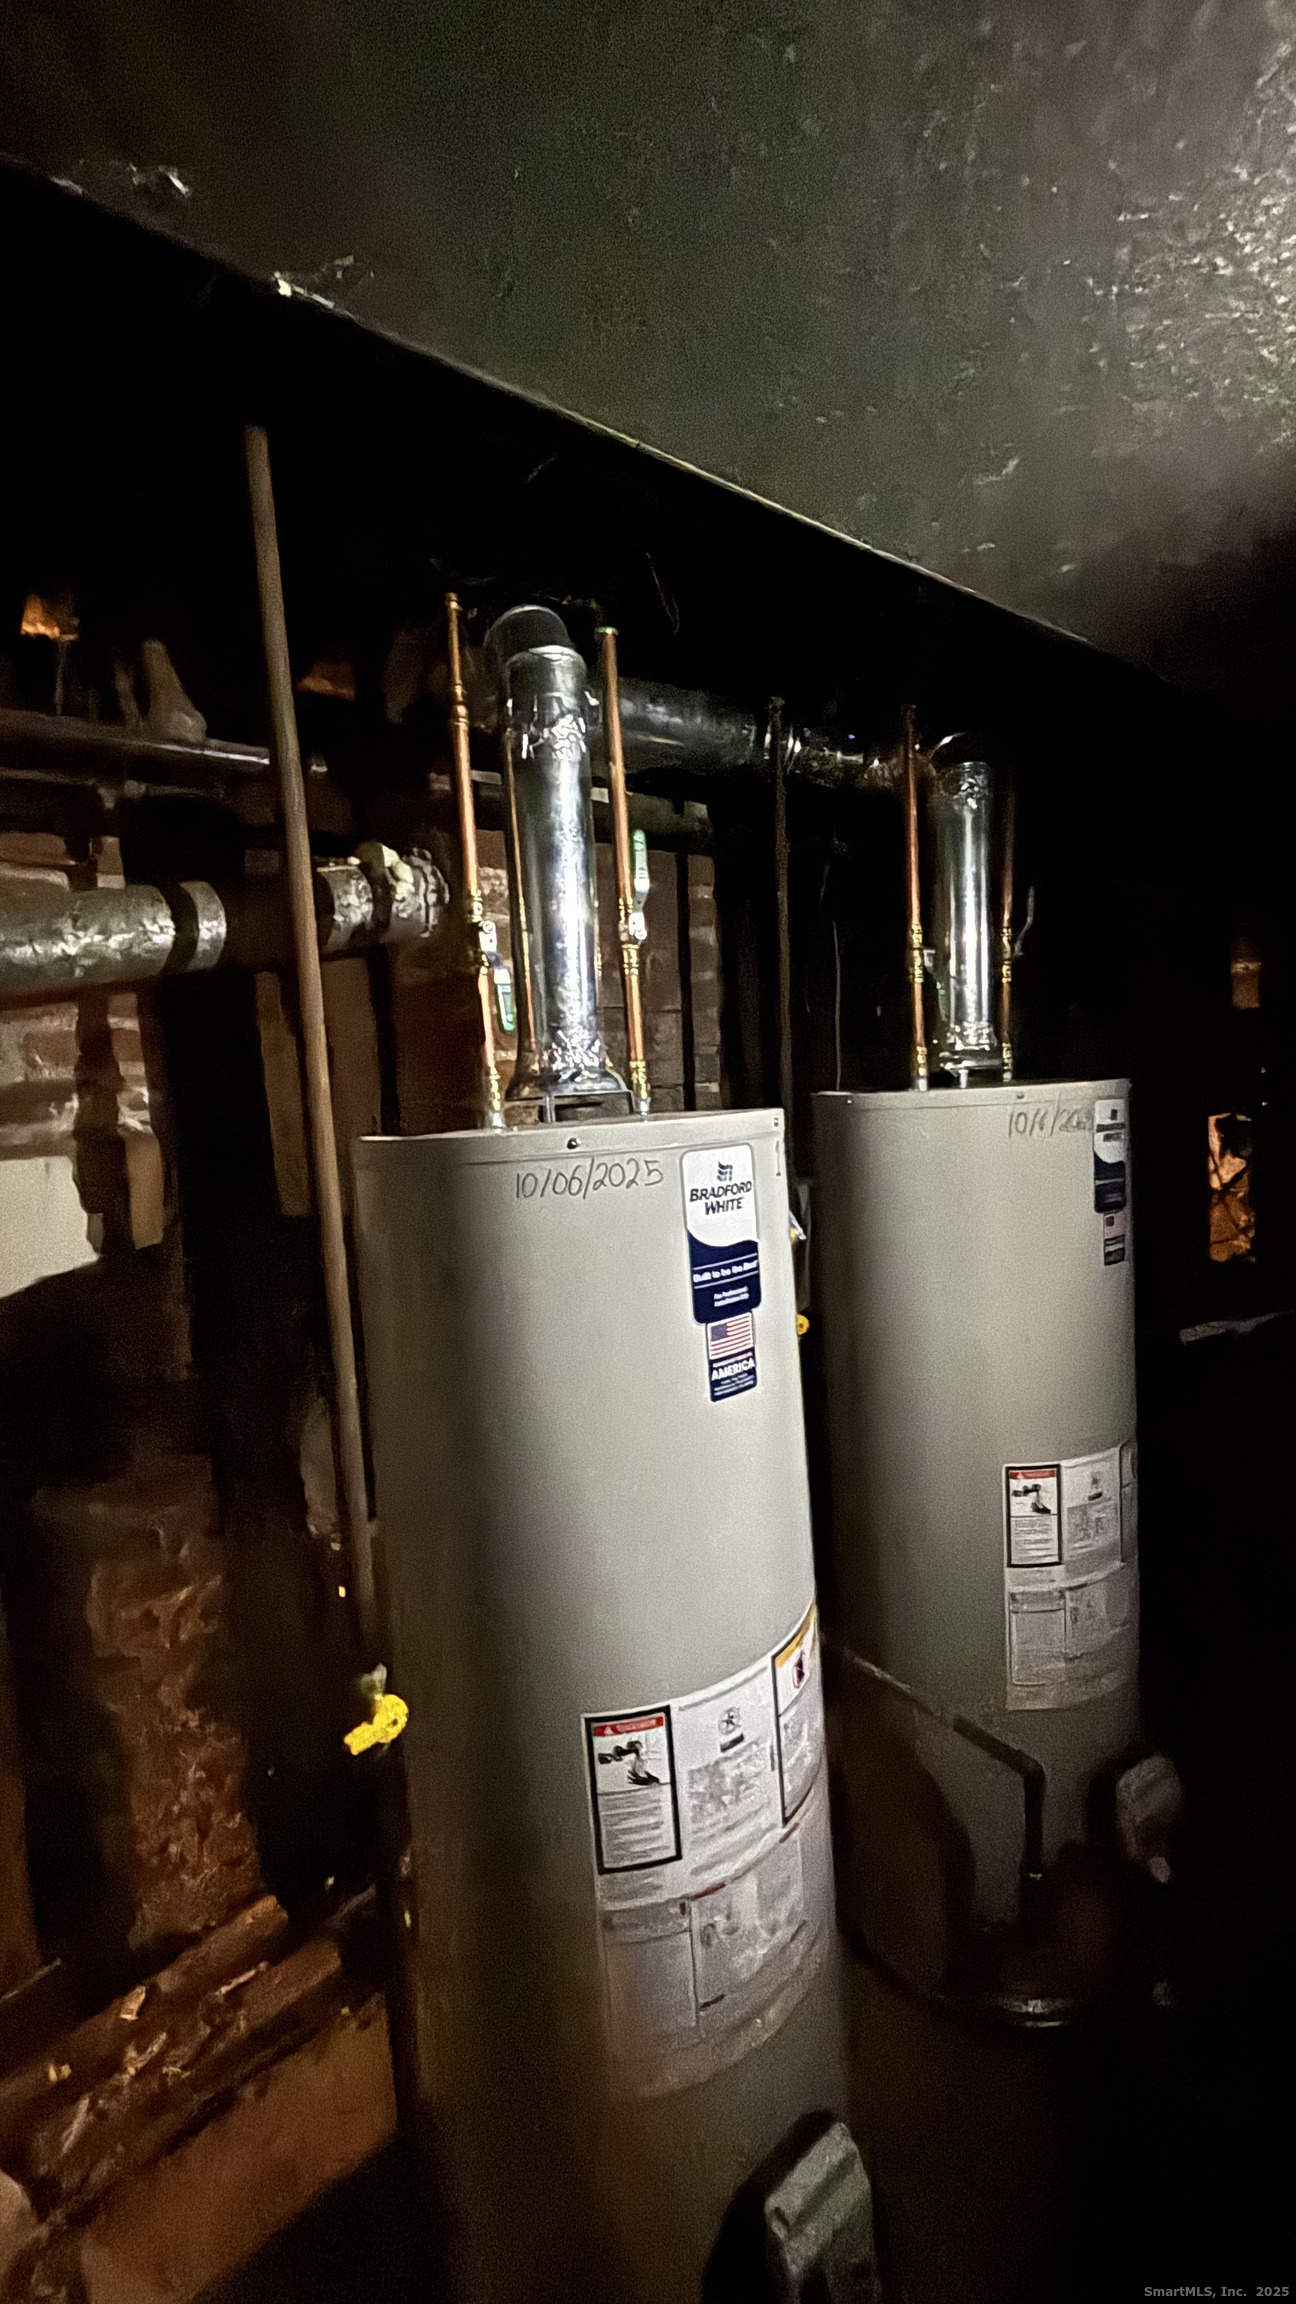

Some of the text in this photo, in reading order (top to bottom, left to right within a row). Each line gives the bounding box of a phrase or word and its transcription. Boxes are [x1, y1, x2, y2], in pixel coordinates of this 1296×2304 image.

[516, 1157, 663, 1199] 10/06/2025
[689, 1180, 752, 1202] BRADFORD
[705, 1196, 744, 1215] WHITE
[711, 1357, 755, 1380] AMERICA
